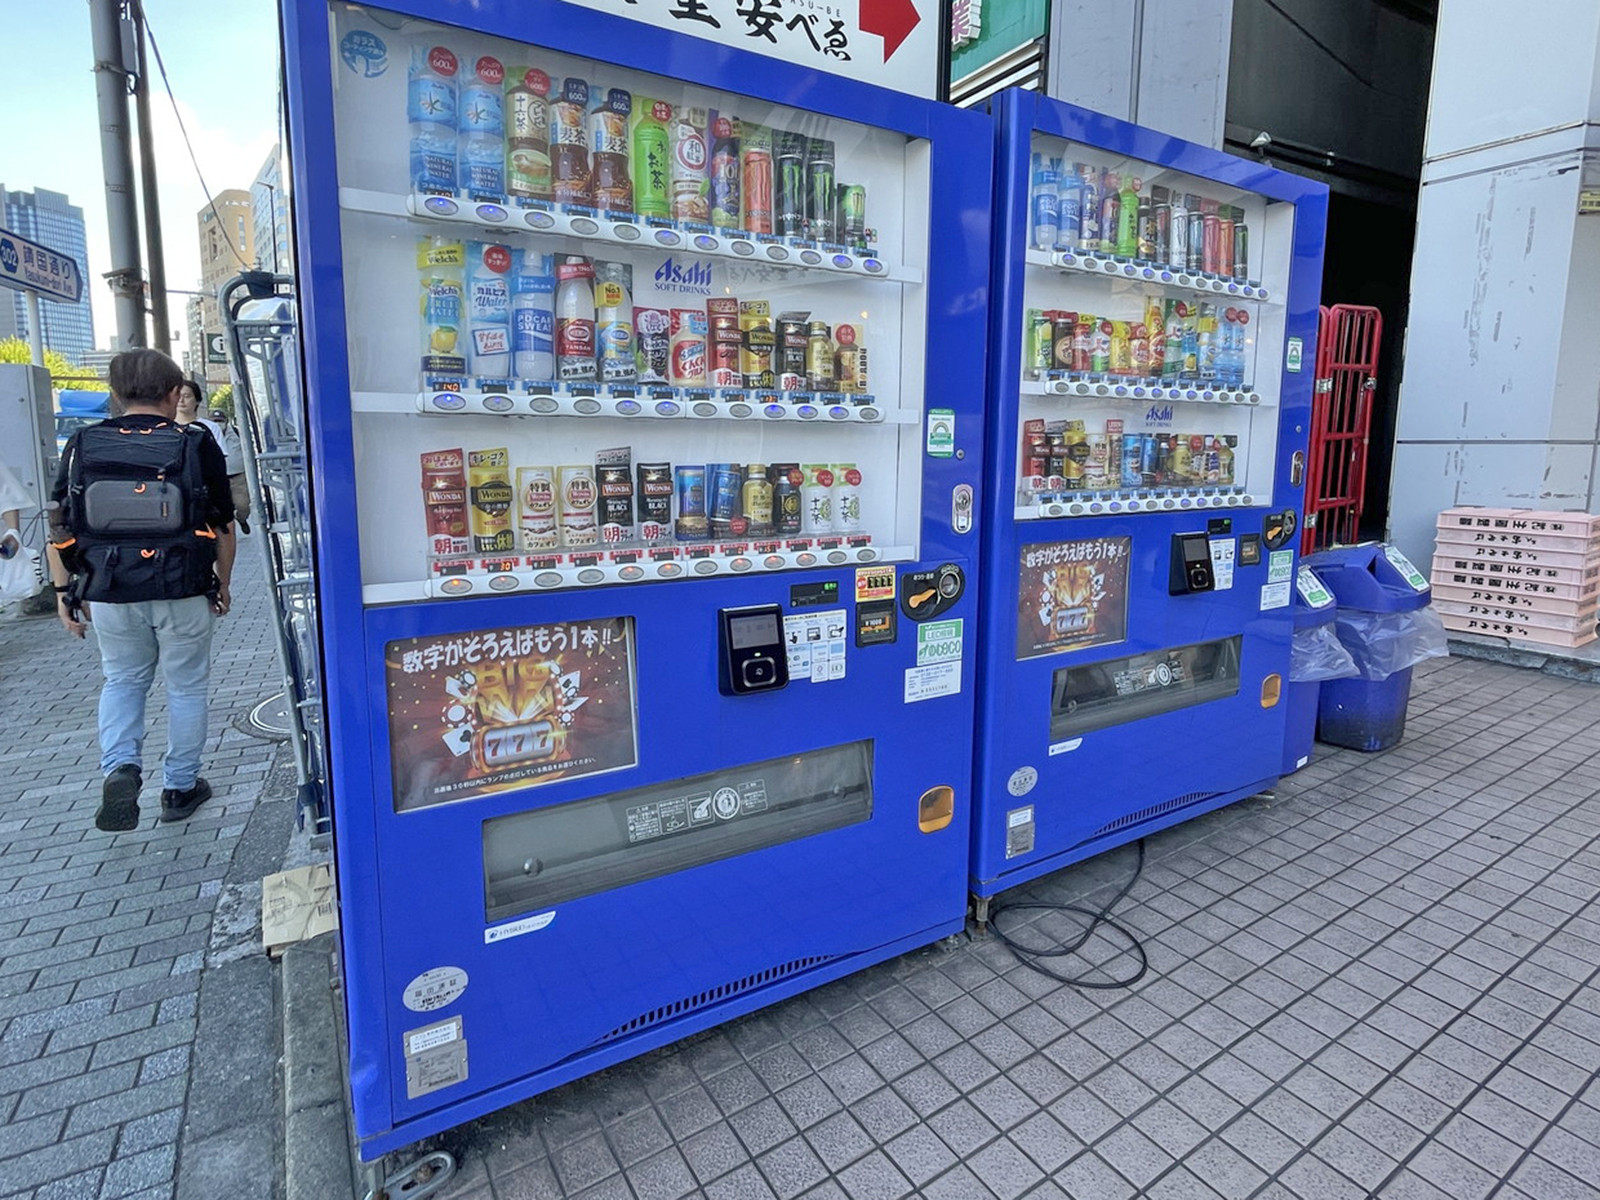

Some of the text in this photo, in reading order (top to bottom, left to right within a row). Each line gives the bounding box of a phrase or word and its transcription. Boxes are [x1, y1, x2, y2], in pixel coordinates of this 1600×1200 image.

[514, 95, 529, 133] 十六茶
[559, 127, 587, 146] 麦茶
[606, 137, 629, 155] 麦茶
[425, 155, 453, 167] NATURAL
[429, 169, 450, 179] WATER
[475, 179, 496, 188] WATER
[655, 257, 712, 287] Asahi
[477, 286, 508, 297] カルピス
[604, 286, 621, 294] No.1
[654, 282, 712, 296] SOFT DRINKS
[475, 296, 508, 307] Water
[717, 371, 732, 386] 朝
[783, 376, 798, 391] 朝
[1145, 405, 1174, 422] Asahi
[530, 482, 551, 493] 特製
[571, 480, 590, 490] 特製
[604, 484, 630, 493] WONDA
[646, 483, 672, 492] WONDA
[431, 491, 462, 501] WONDA
[481, 489, 510, 499] WONDA
[810, 496, 823, 525] 十六茶
[840, 495, 850, 523] 十六茶
[603, 526, 619, 542] 朝
[643, 524, 659, 540] 朝
[434, 538, 452, 555] 朝
[527, 540, 557, 548] カフェオレ
